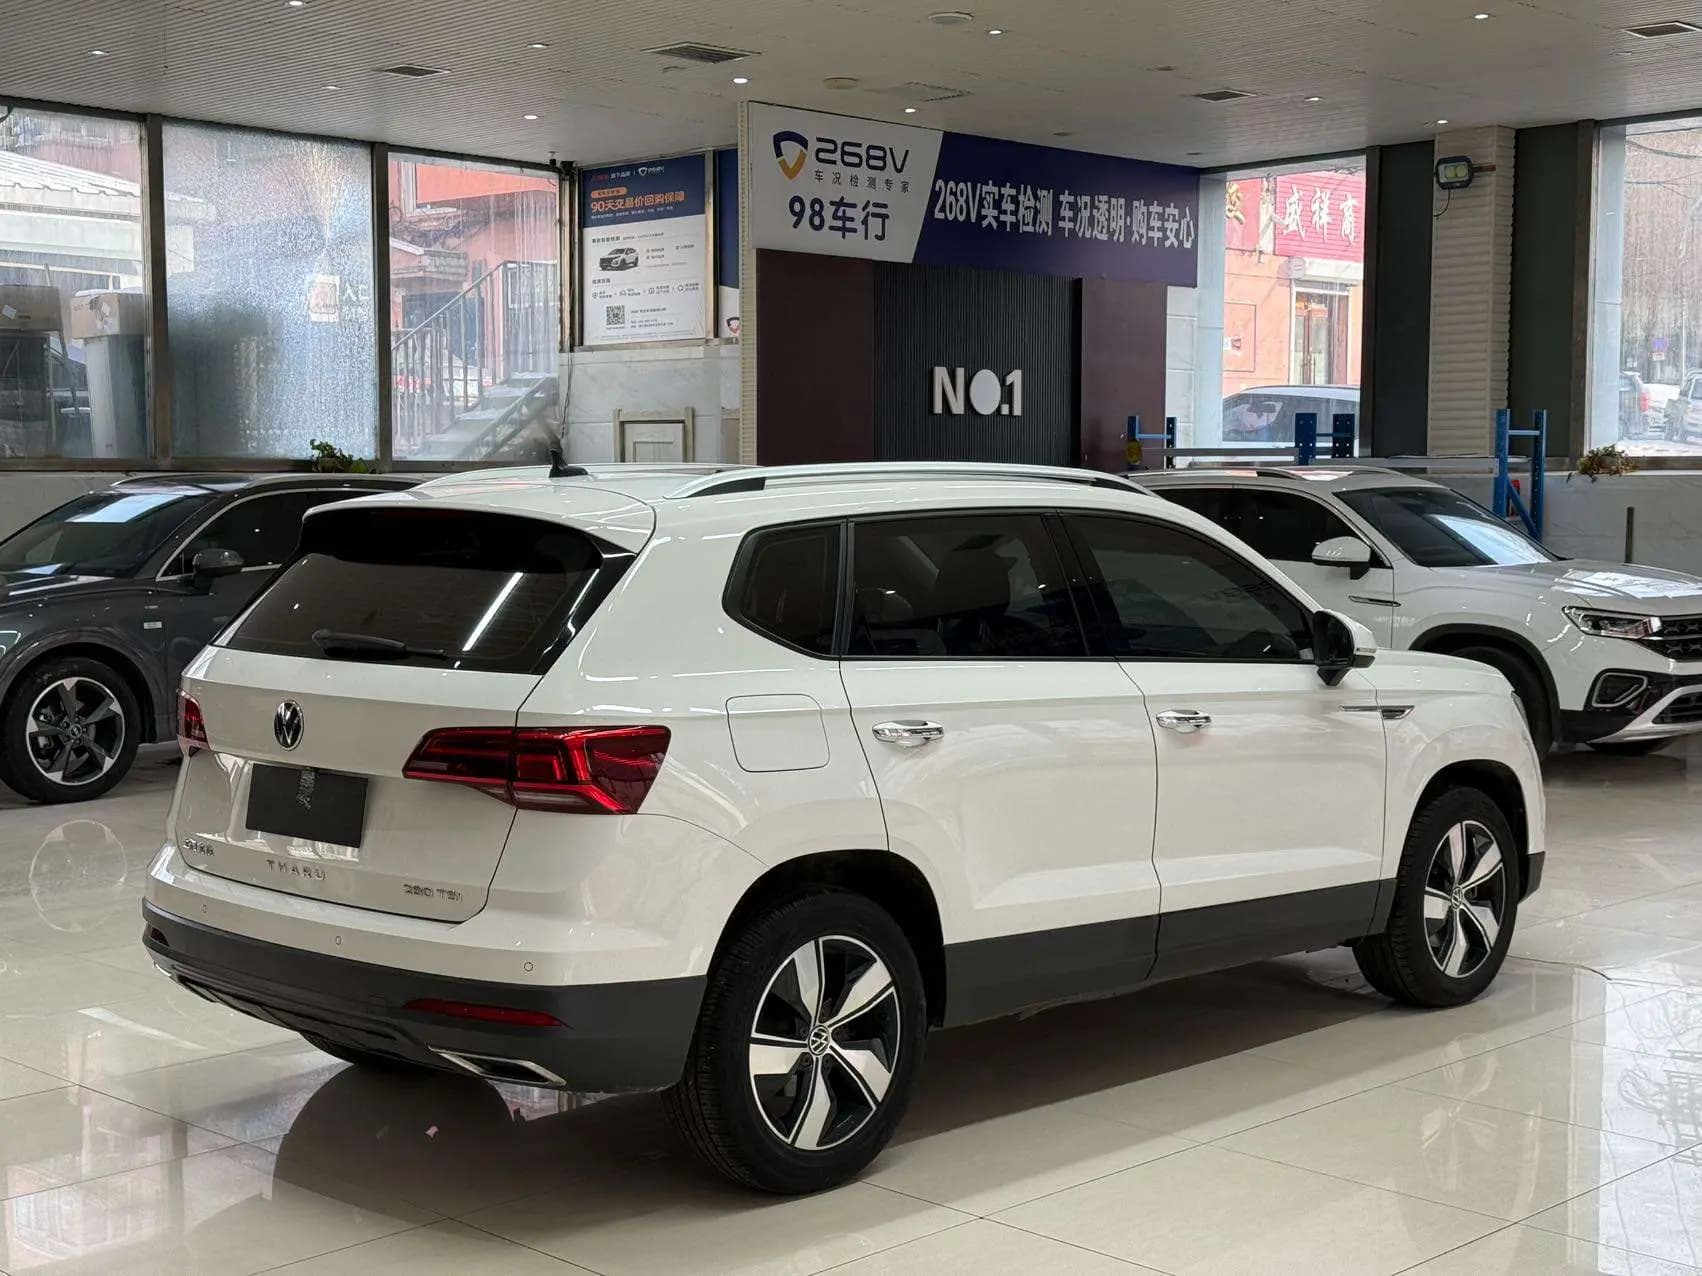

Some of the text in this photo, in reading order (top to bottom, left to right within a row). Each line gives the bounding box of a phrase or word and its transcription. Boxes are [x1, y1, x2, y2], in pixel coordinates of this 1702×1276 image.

[814, 136, 910, 174] 268V
[813, 168, 911, 194] 车况检测专家
[788, 194, 890, 242] 98车行
[933, 178, 1054, 237] 268V实车检测
[1058, 189, 1196, 249] 车况透明·购车安心
[932, 365, 1023, 417] NO.1
[265, 858, 328, 882] THARU
